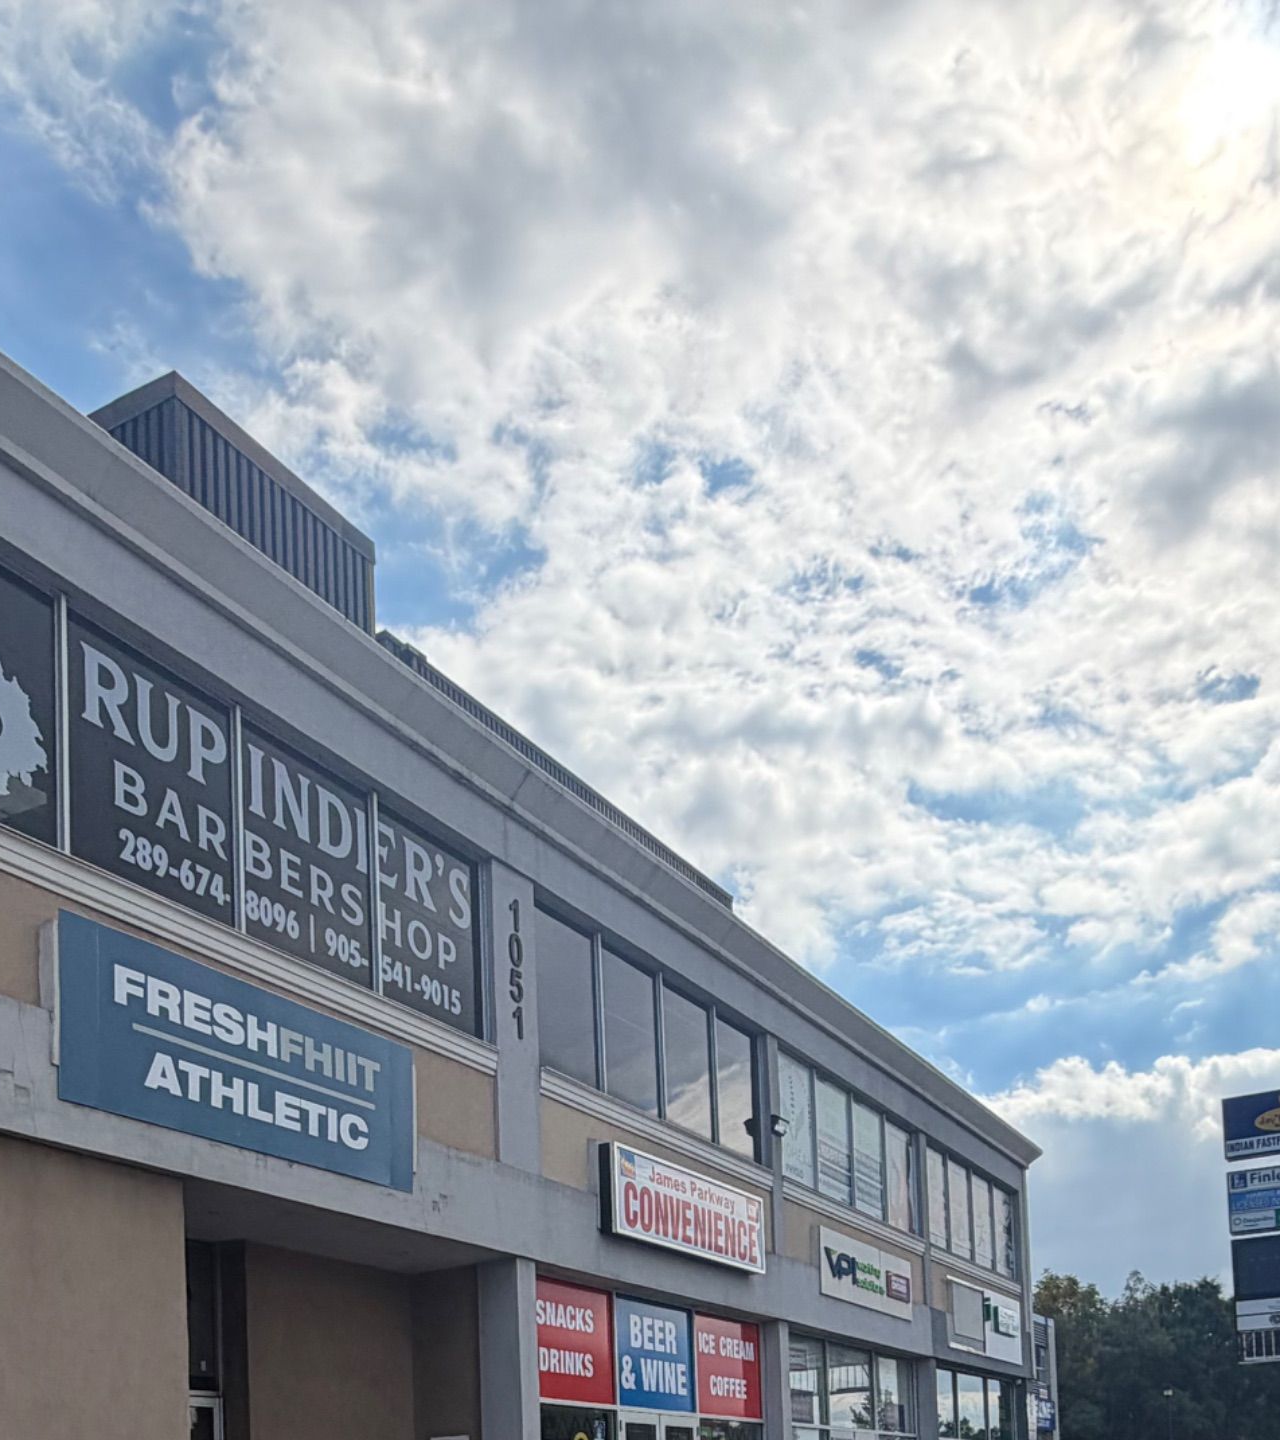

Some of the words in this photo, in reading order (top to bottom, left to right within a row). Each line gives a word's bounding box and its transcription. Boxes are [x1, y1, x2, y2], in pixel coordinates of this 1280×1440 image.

[507, 899, 524, 1040] 1051
[113, 963, 382, 1092] FRESHFHIIT
[144, 1052, 369, 1150] ATHLETIC
[1227, 1141, 1254, 1153] INDIAN
[649, 1165, 687, 1194] James
[690, 1180, 736, 1216] Parkway
[624, 1181, 758, 1265] CONVENIENCE
[536, 1299, 595, 1334] SNACKS
[629, 1314, 678, 1355] BEER
[538, 1346, 594, 1378] DRINKS
[698, 1331, 716, 1355] ICE
[720, 1336, 755, 1362] CREAM
[621, 1355, 637, 1391] &
[640, 1358, 688, 1397] WINE
[709, 1374, 748, 1400] COFFEE
